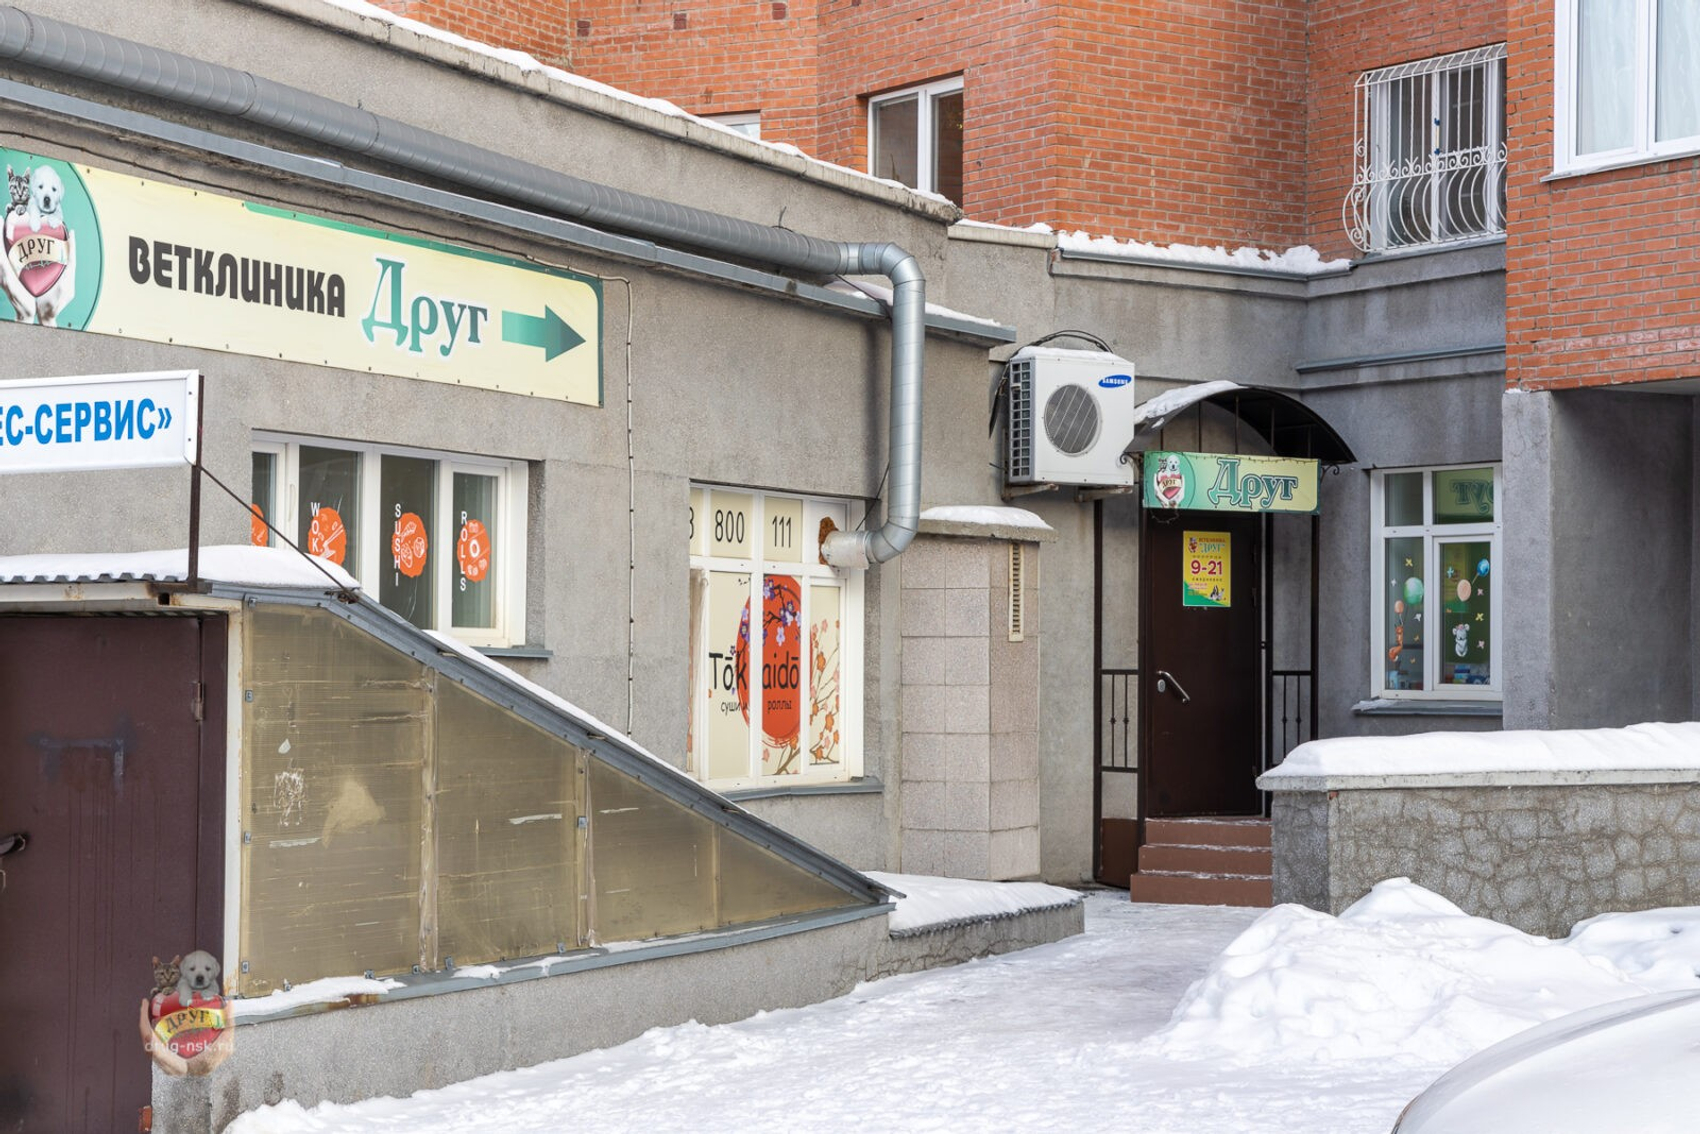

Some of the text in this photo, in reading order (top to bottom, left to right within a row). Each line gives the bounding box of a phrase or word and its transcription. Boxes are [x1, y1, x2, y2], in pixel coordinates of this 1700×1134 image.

[18, 238, 55, 263] ДРУГ
[362, 257, 488, 356] Друг
[0, 398, 172, 447] С-СЕРВИС»
[1207, 458, 1299, 509] Друг
[310, 501, 321, 553] WOK
[393, 503, 402, 587] SUSHI
[459, 510, 468, 592] ROLLS
[715, 509, 745, 544] 800
[772, 515, 792, 549] 111
[1190, 560, 1223, 575] 9-21
[720, 701, 741, 716] суши
